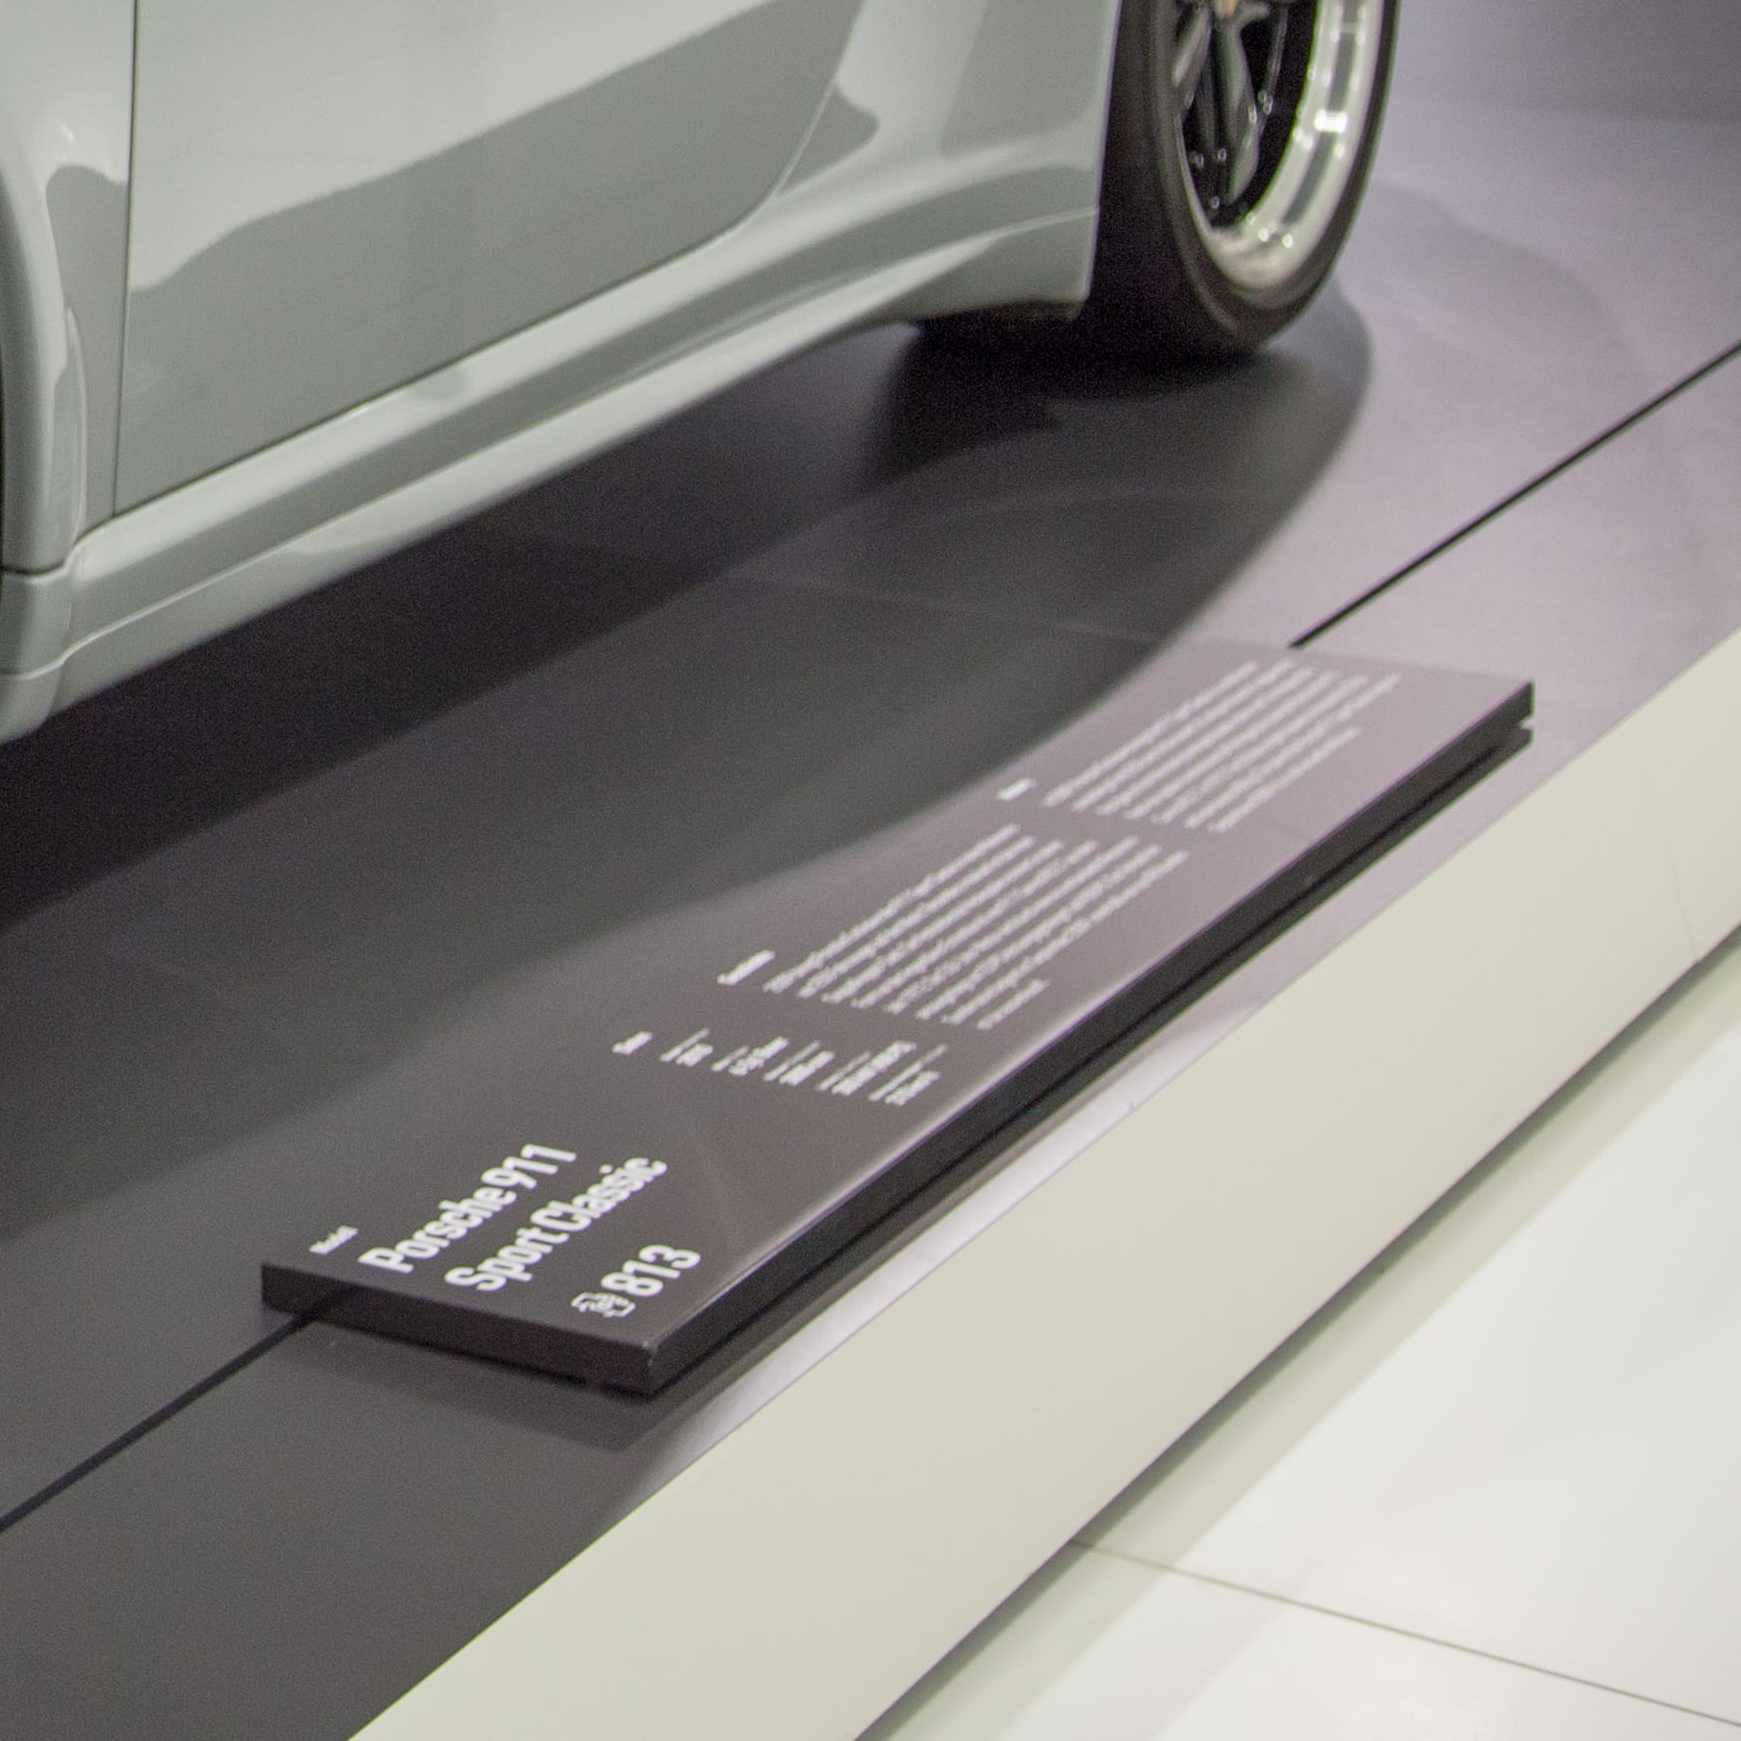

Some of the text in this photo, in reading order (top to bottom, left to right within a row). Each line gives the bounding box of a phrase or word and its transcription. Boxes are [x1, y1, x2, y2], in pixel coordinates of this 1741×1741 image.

[358, 1187, 517, 1273] Porsche
[480, 1144, 577, 1189] 911
[444, 1156, 668, 1292] Sport Classic
[601, 1244, 702, 1298] 813
